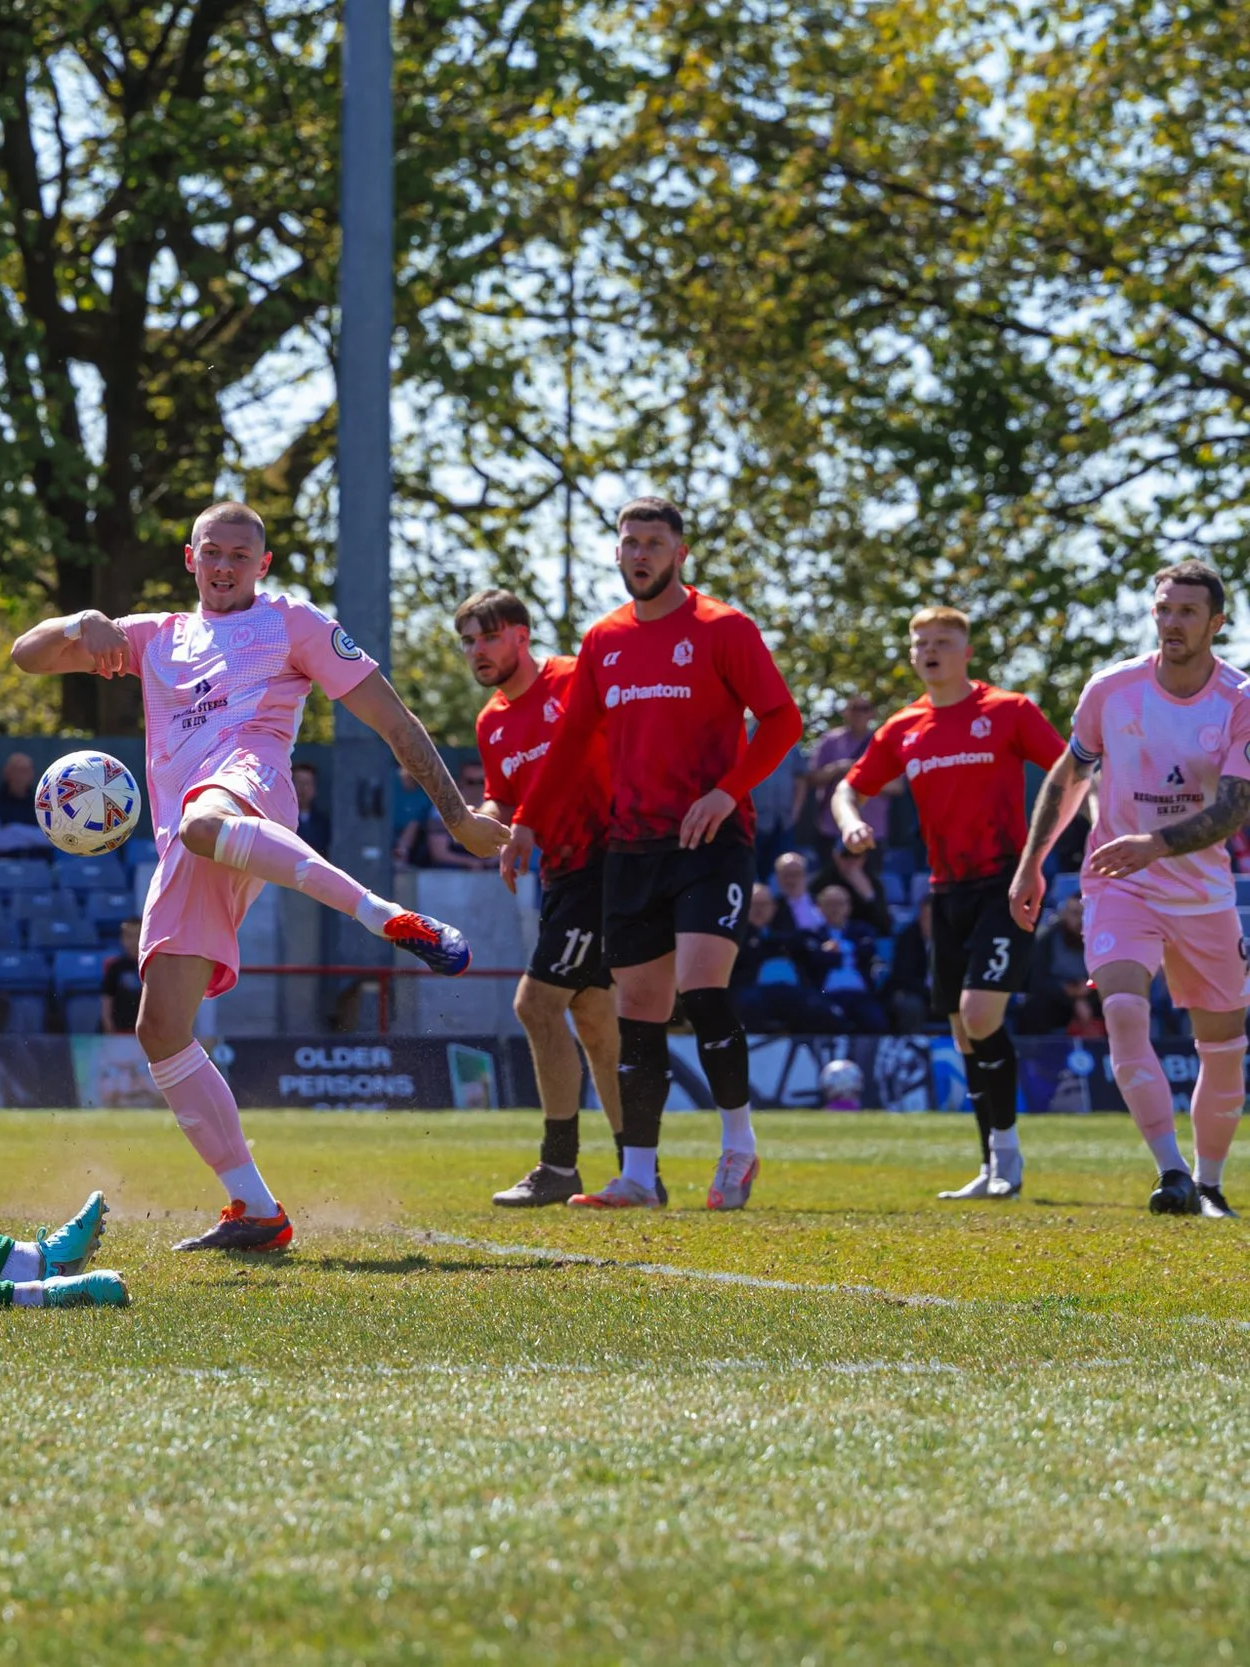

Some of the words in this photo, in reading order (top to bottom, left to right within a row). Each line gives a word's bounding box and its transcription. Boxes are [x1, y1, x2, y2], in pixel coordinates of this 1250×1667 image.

[621, 683, 691, 704] phantom
[511, 742, 551, 771] phant
[922, 752, 995, 774] phantom
[727, 883, 743, 919] 9
[561, 927, 594, 968] 11
[989, 937, 1010, 972] 3
[294, 1046, 393, 1069] OLDER
[279, 1074, 415, 1098] PERSONS
